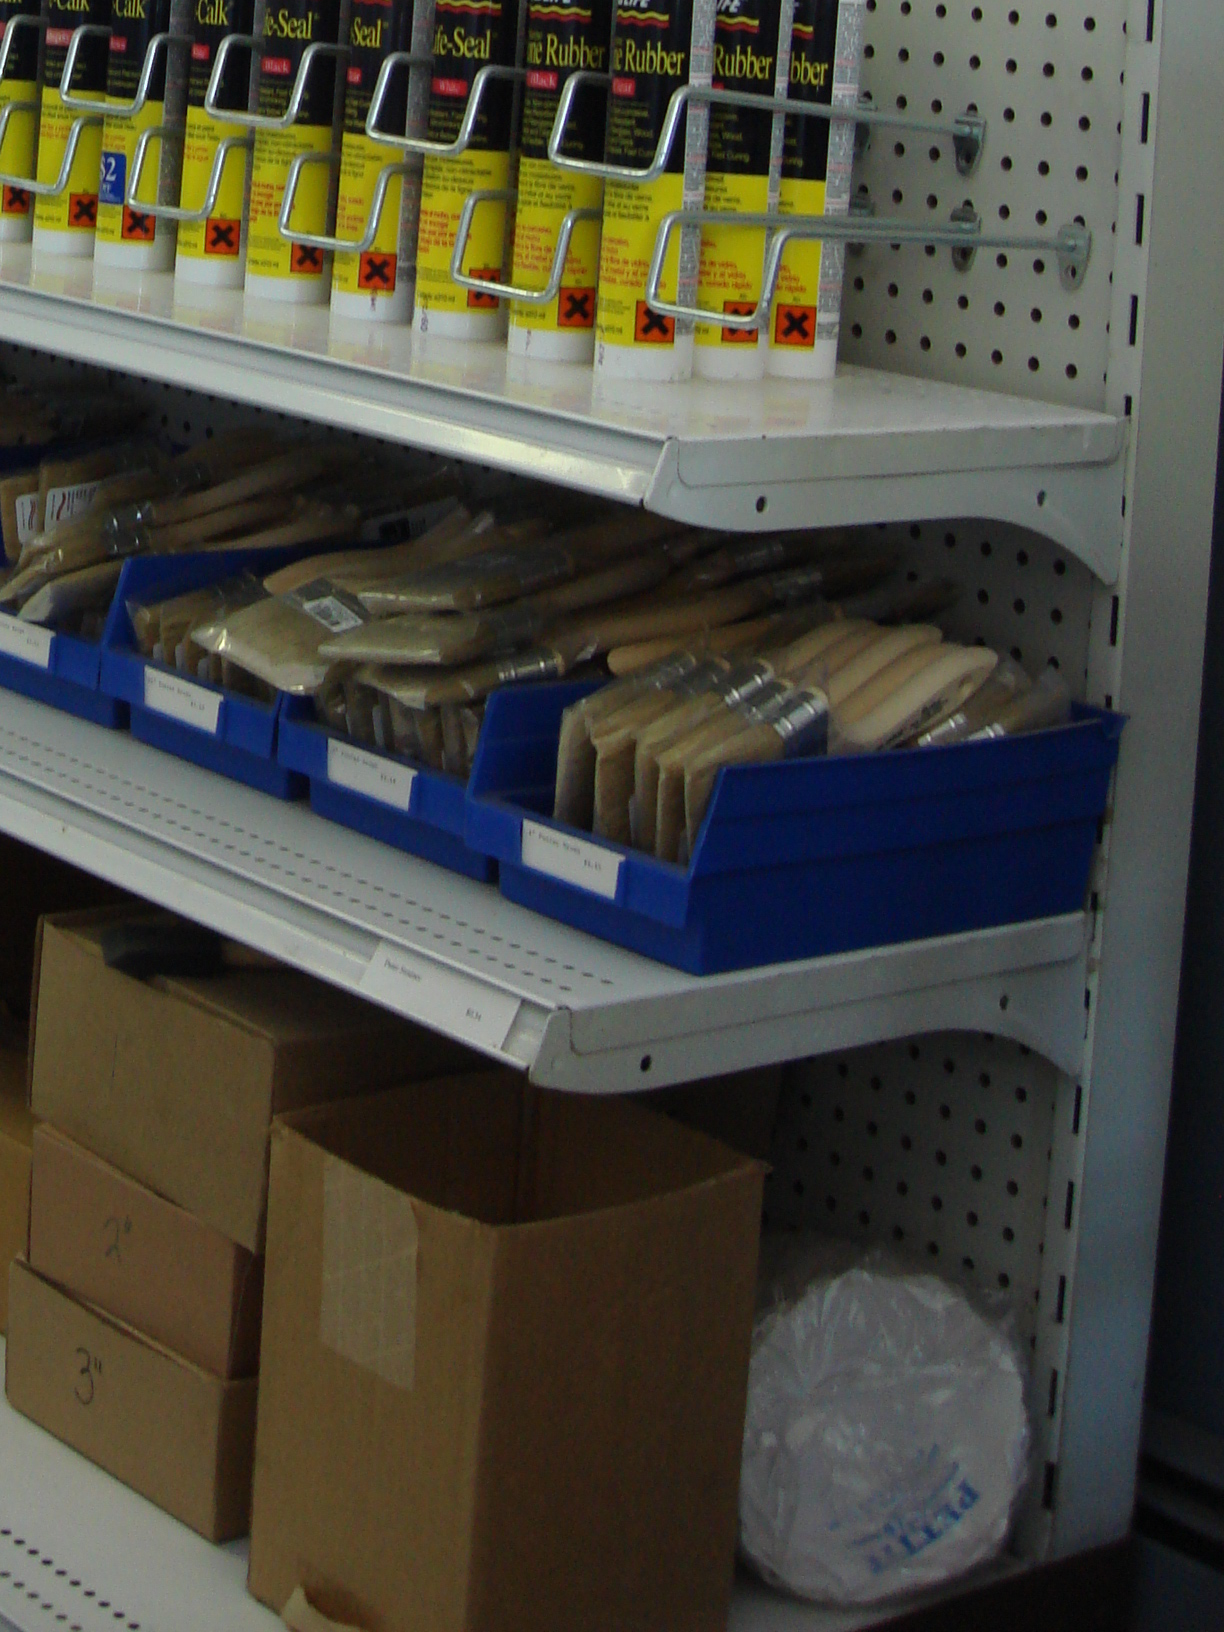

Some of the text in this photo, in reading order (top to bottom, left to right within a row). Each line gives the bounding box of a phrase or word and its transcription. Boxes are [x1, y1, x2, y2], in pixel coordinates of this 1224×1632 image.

[263, 57, 289, 73] Black
[544, 33, 607, 69] Rubber
[625, 38, 686, 77] Rubber
[714, 42, 774, 81] Rubber
[528, 70, 558, 89] Black
[74, 1346, 103, 1406] 3"
